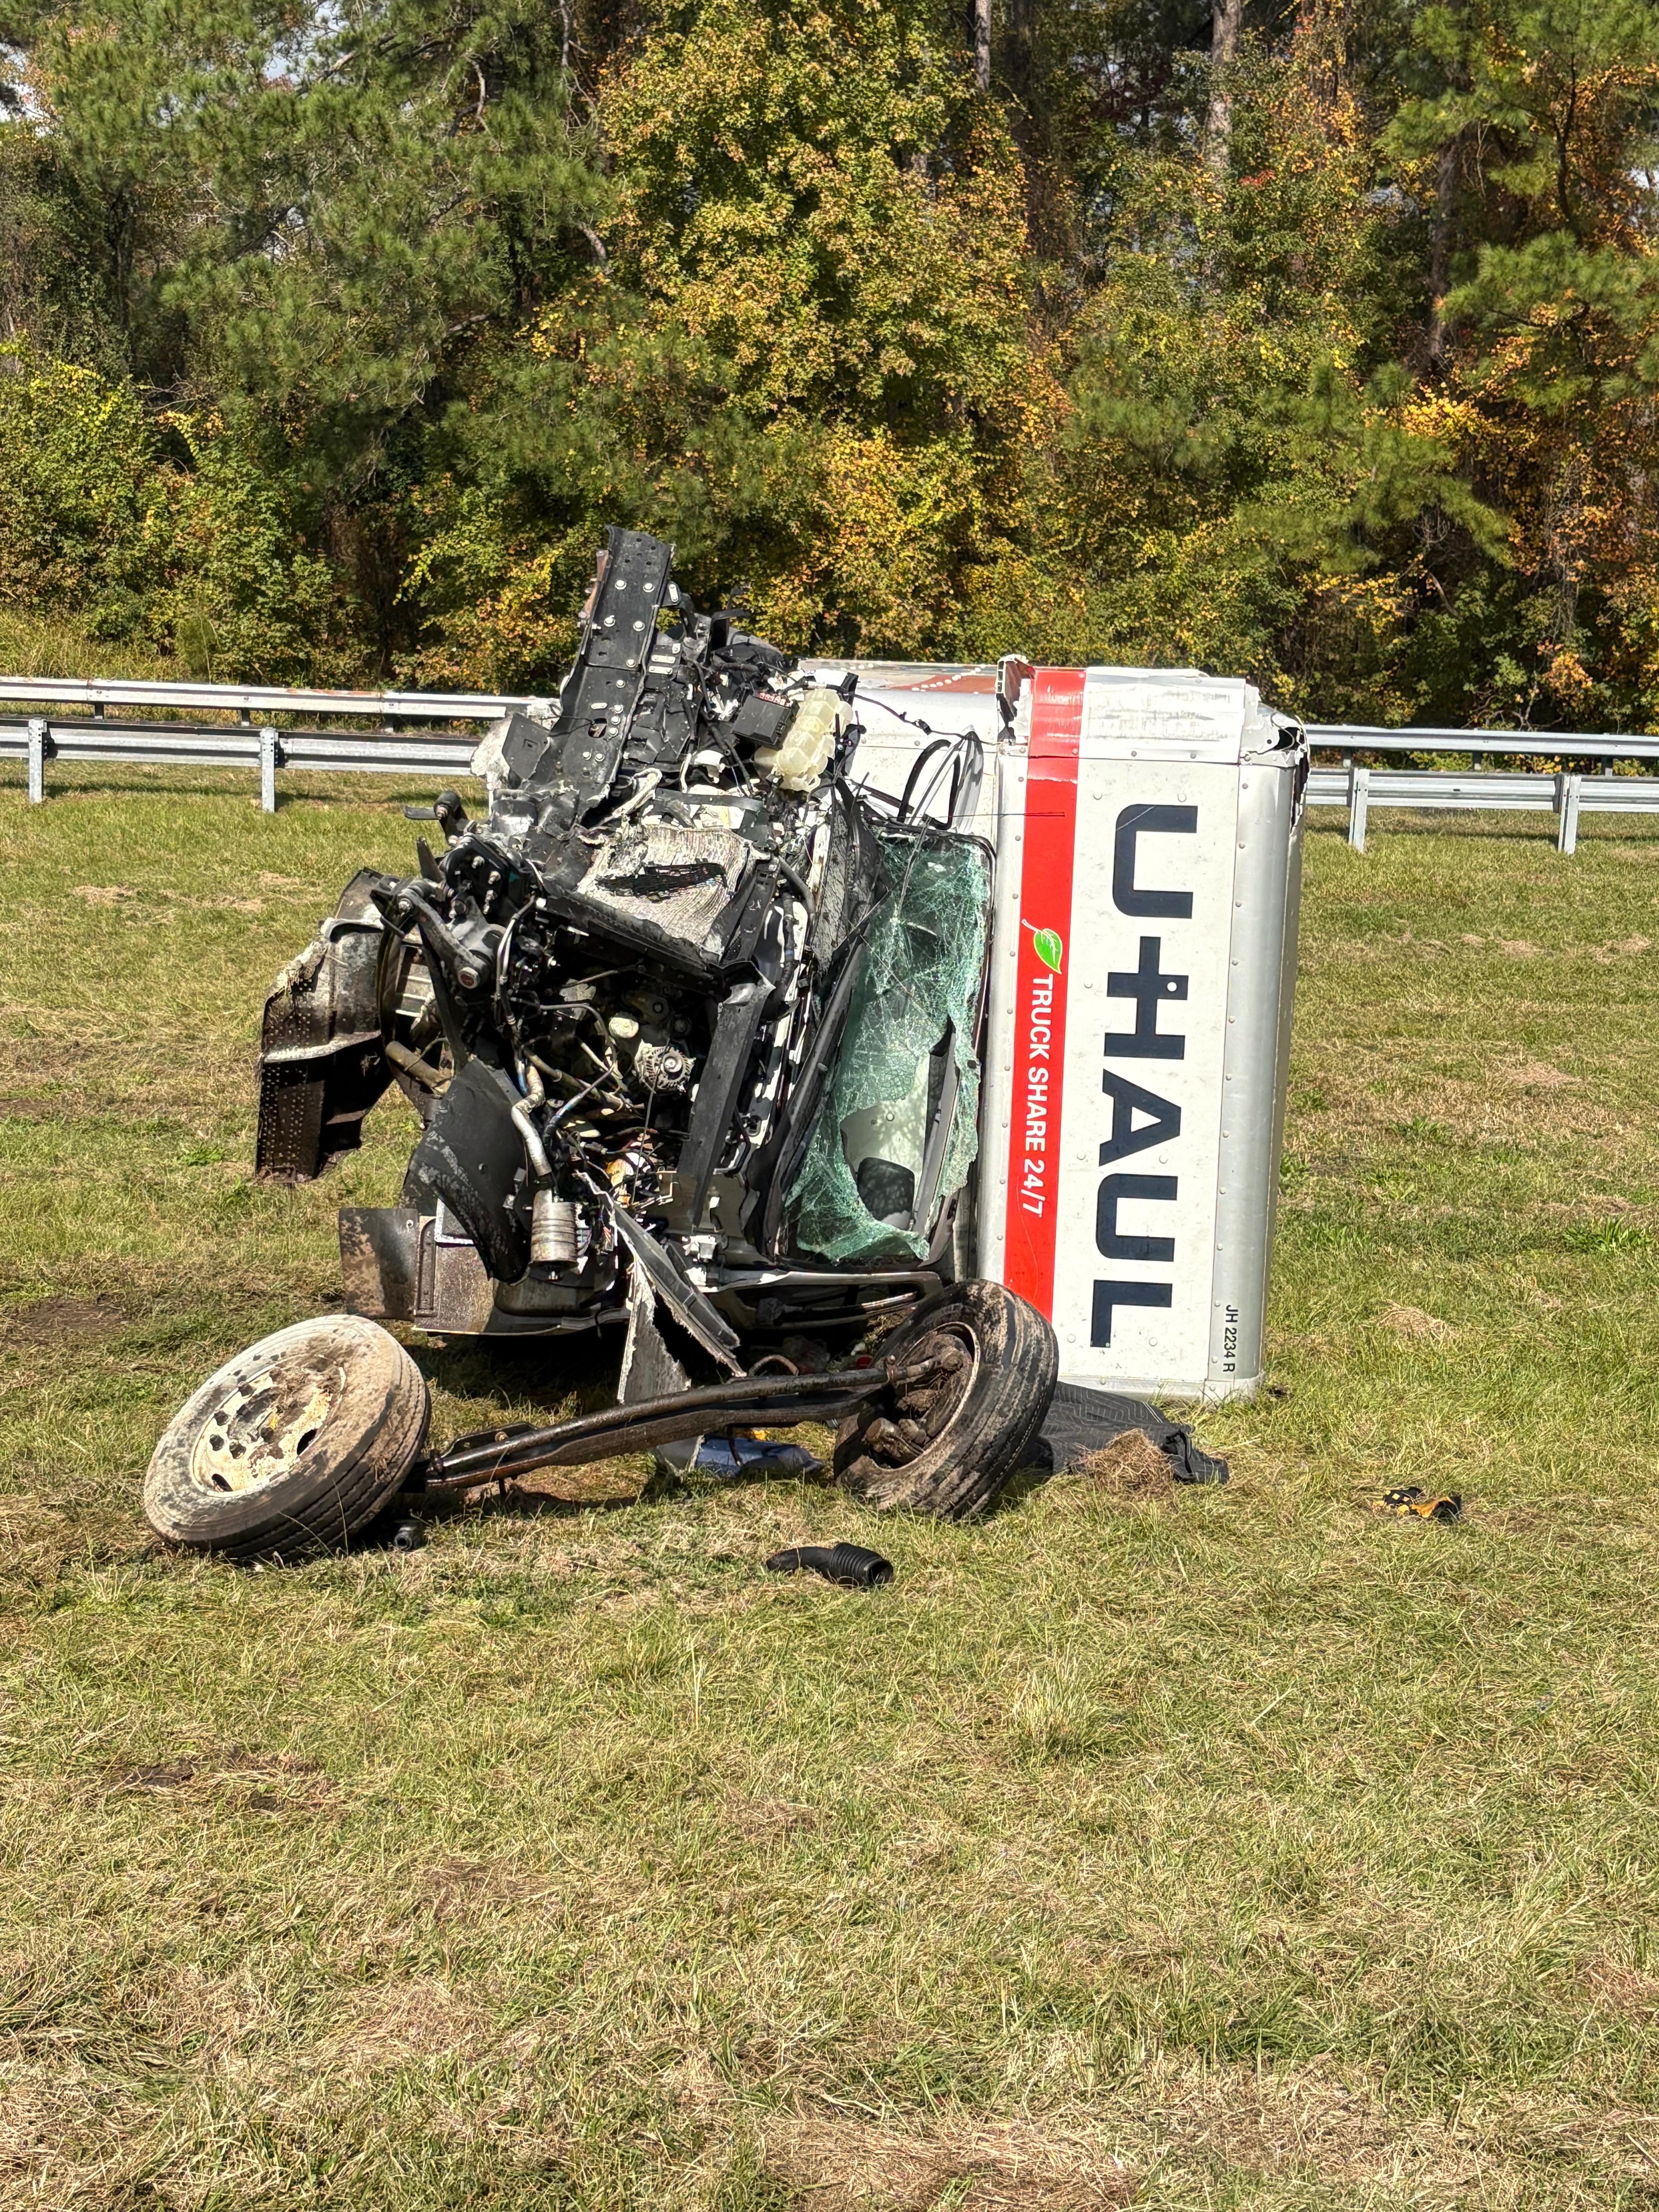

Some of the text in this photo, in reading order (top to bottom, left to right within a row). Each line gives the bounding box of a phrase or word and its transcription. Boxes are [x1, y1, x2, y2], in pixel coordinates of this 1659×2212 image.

[1020, 974, 1053, 1216] TRUCK SHARE 24/7
[1090, 804, 1198, 1348] U-HAUL
[1223, 1304, 1239, 1372] JH 2234 R
